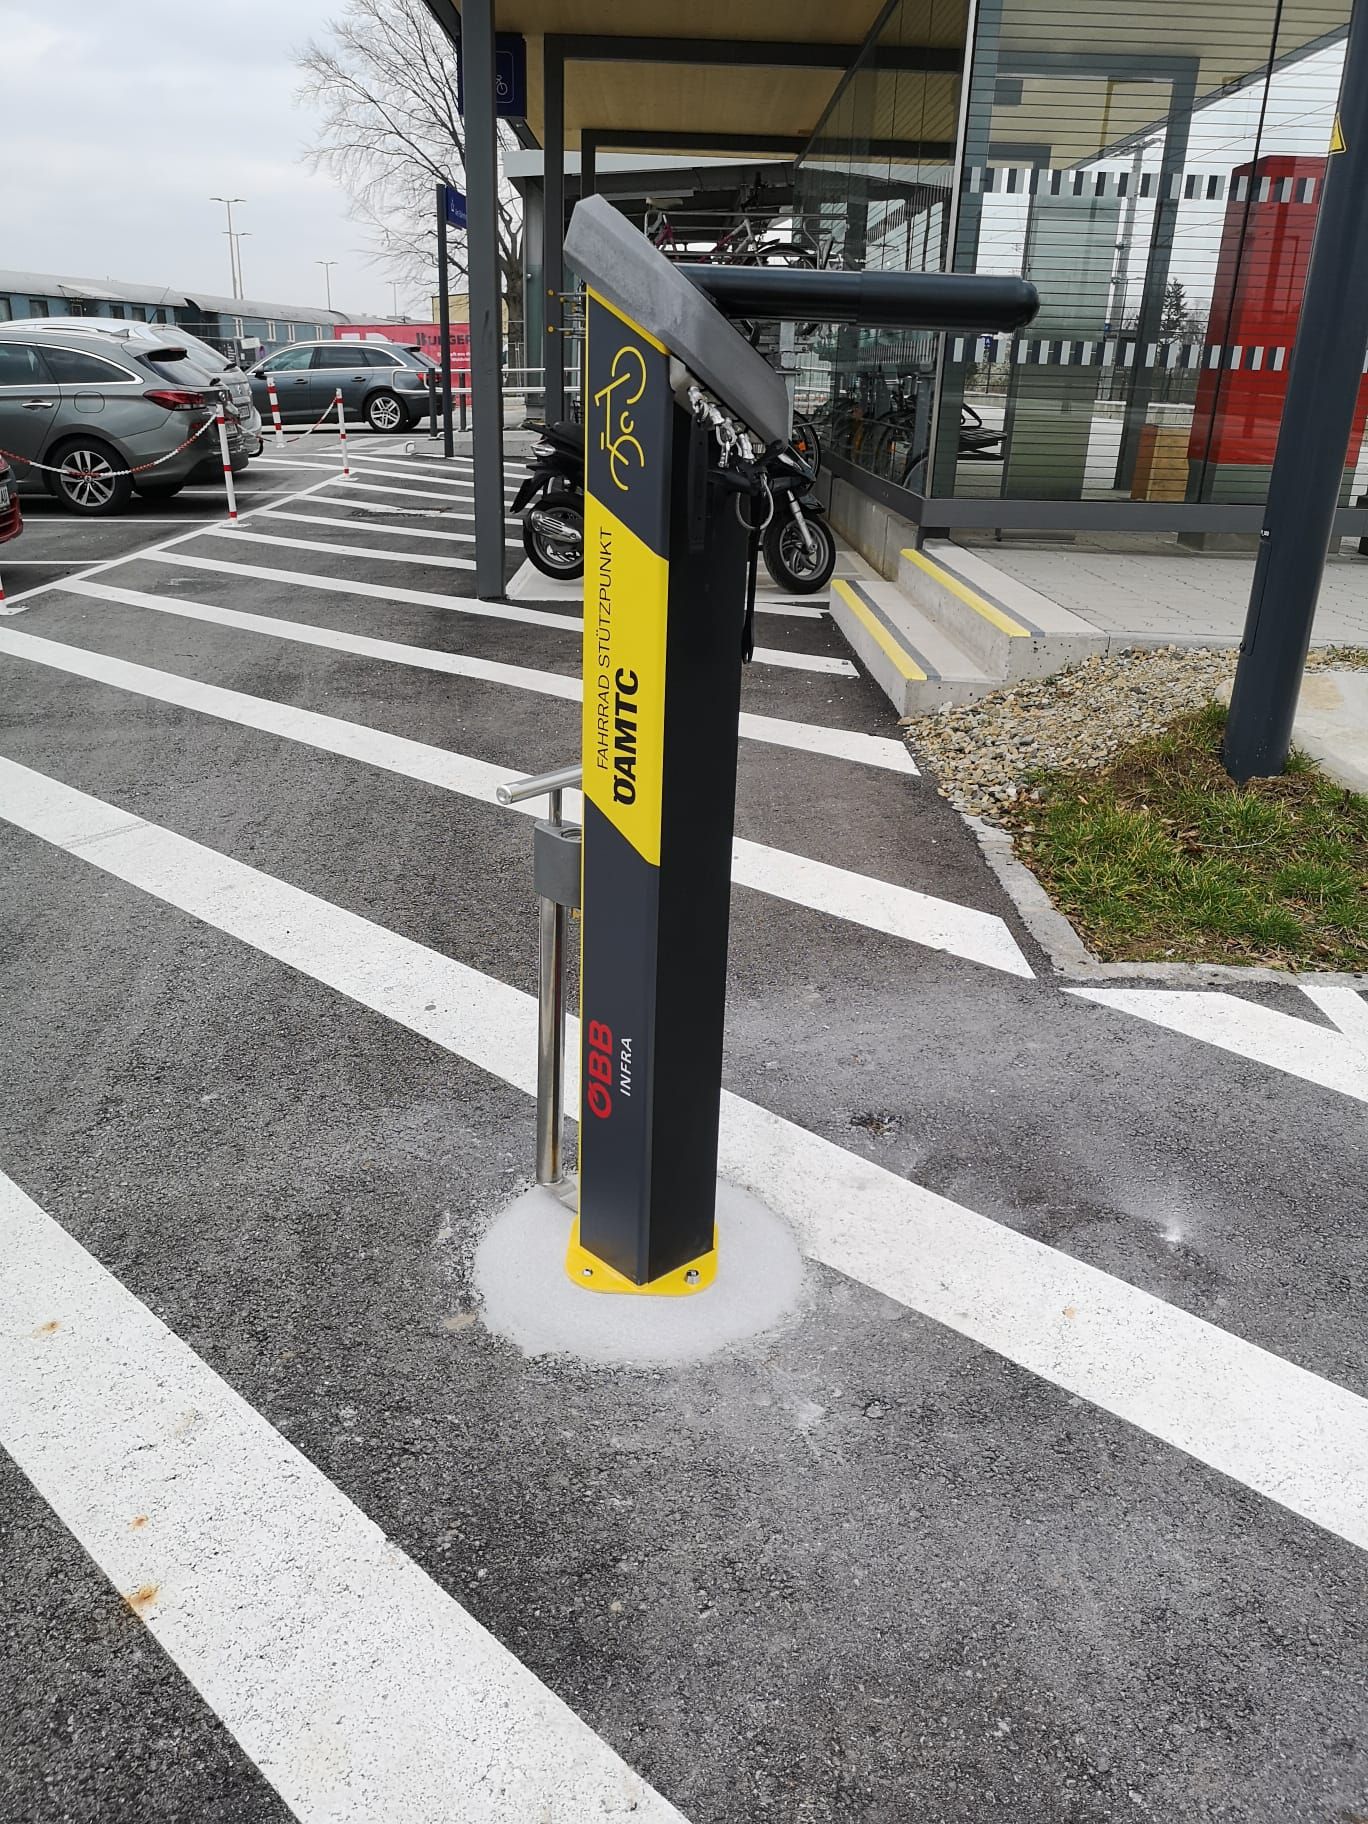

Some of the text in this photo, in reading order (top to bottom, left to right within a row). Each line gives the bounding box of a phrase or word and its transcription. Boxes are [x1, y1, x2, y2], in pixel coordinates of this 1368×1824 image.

[595, 526, 614, 769] FAHRRAD STÜTZPUNKT
[613, 668, 639, 805] ÖAMTC
[587, 1020, 613, 1119] ÖBB
[619, 1038, 633, 1097] INFRA
